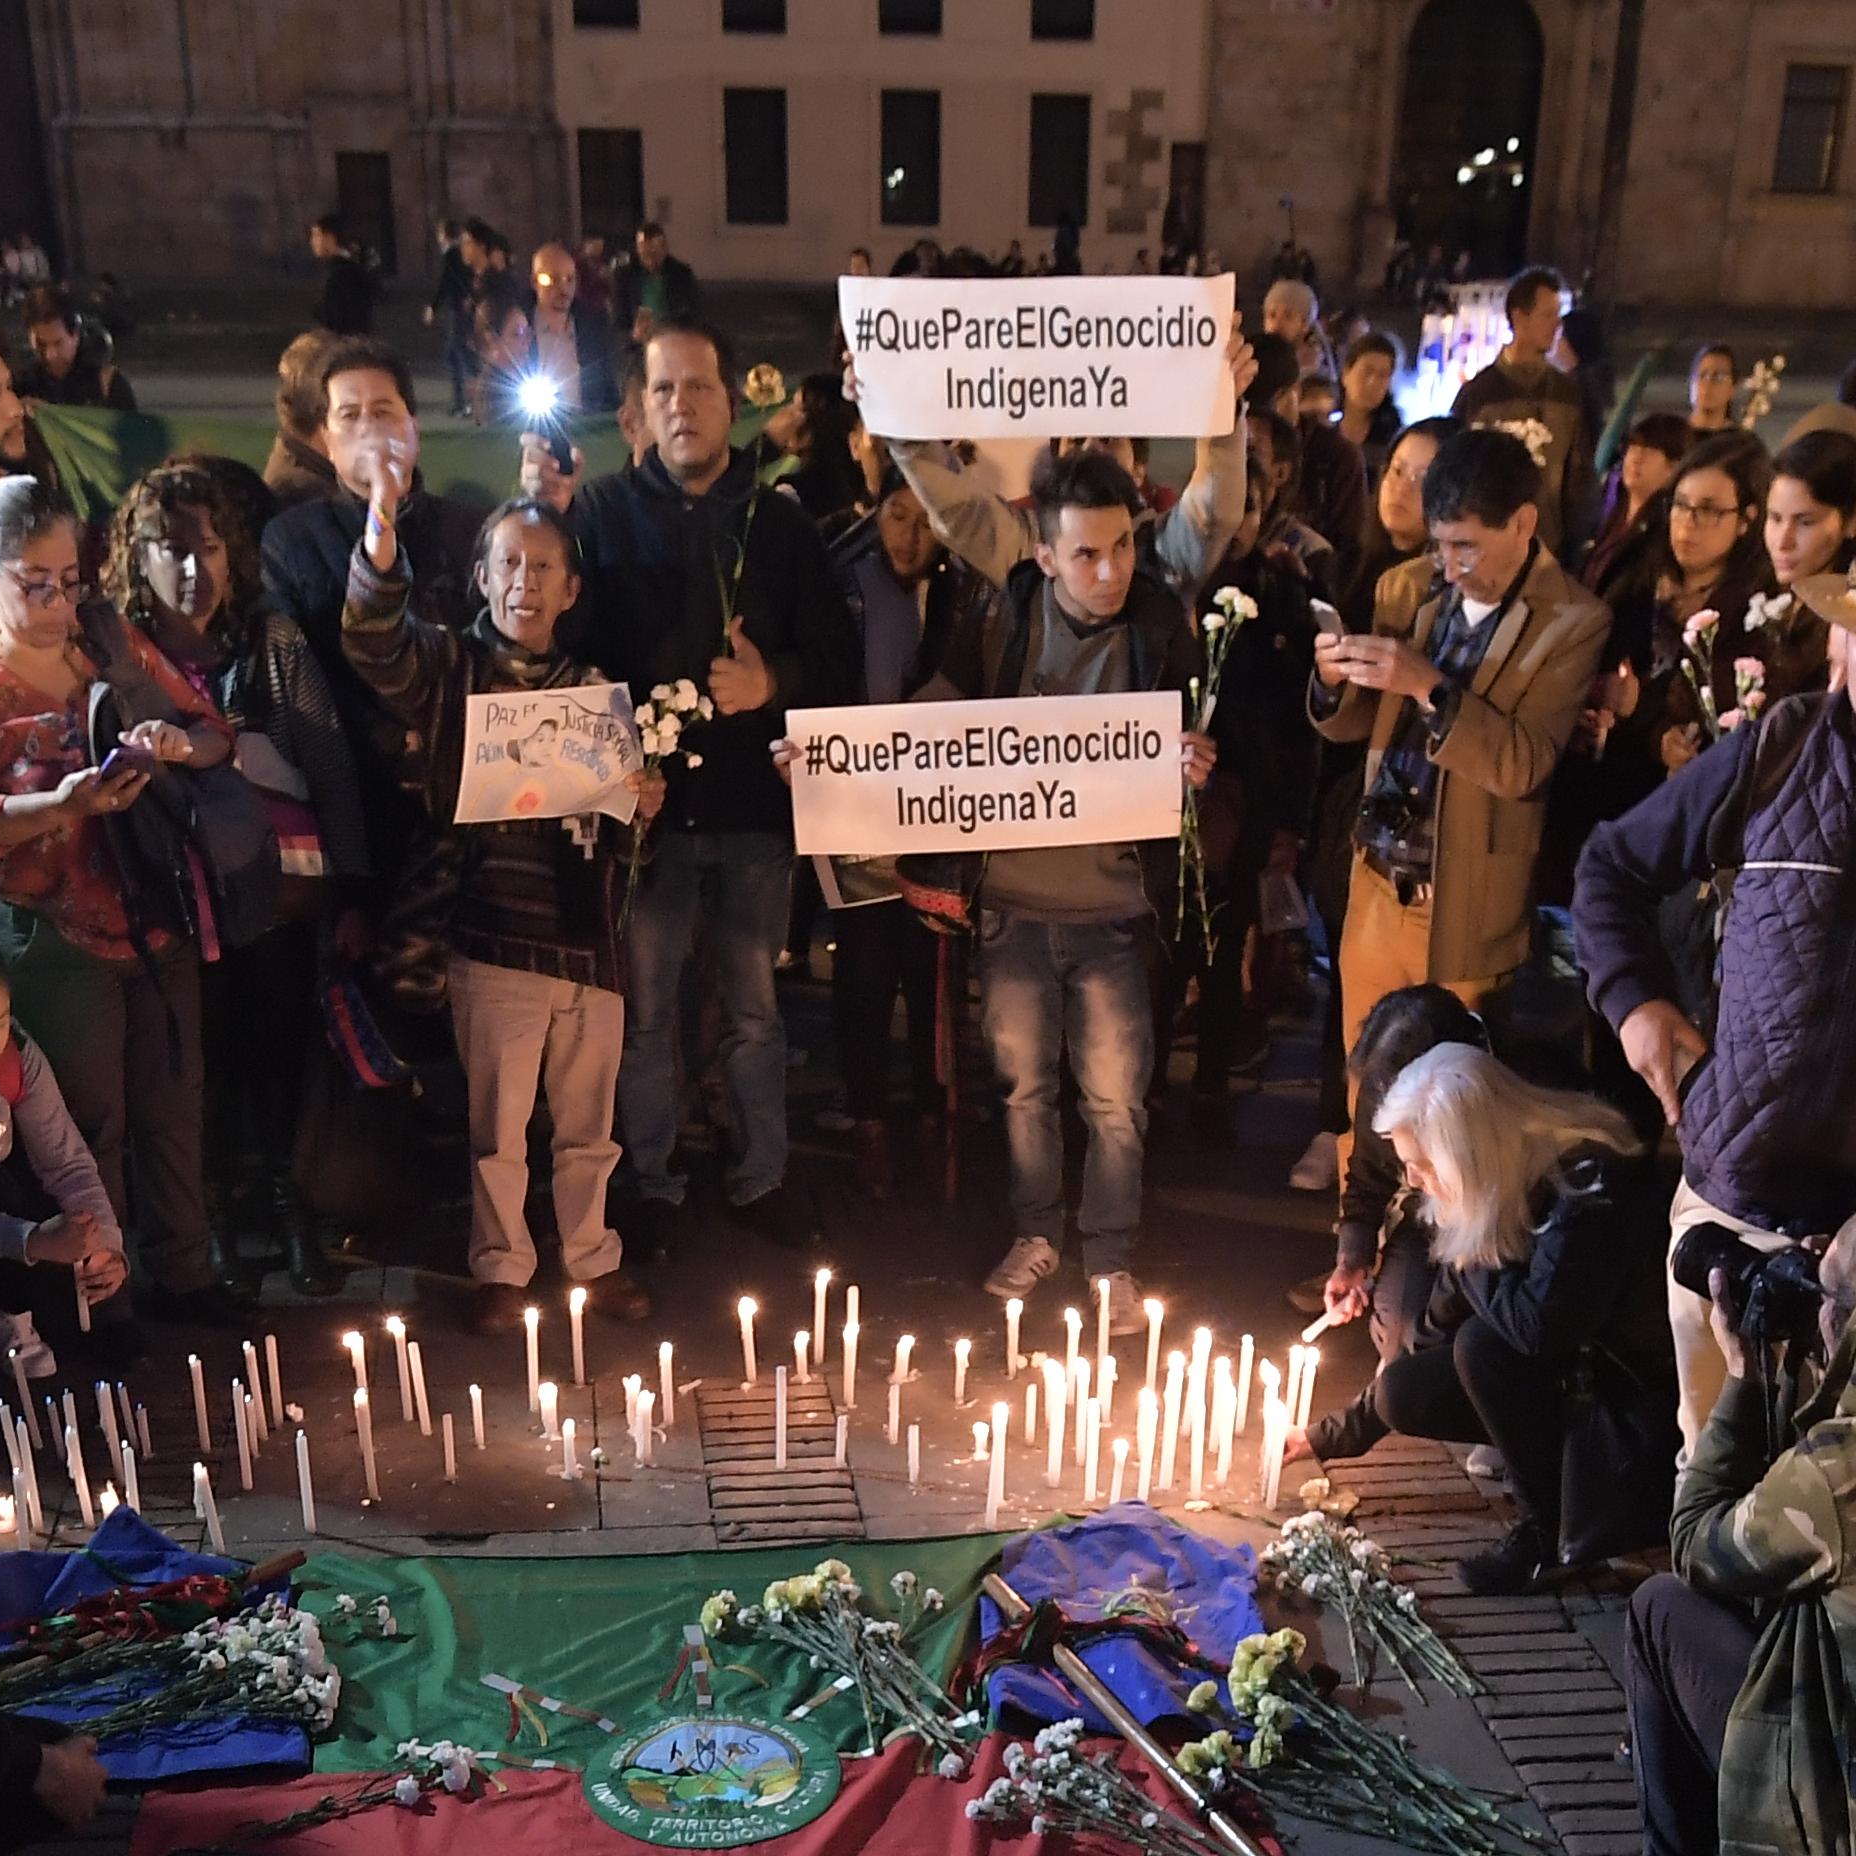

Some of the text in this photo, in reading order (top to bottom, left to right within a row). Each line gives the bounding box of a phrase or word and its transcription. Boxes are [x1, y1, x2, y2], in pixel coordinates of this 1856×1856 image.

[855, 305, 1217, 353] #QuePareElGenocidio
[946, 365, 1128, 420] IndigenaYa
[485, 702, 518, 733] PAZ
[805, 720, 1162, 776] #QuePareElGenocidio
[897, 780, 1076, 834] IndigenaYa
